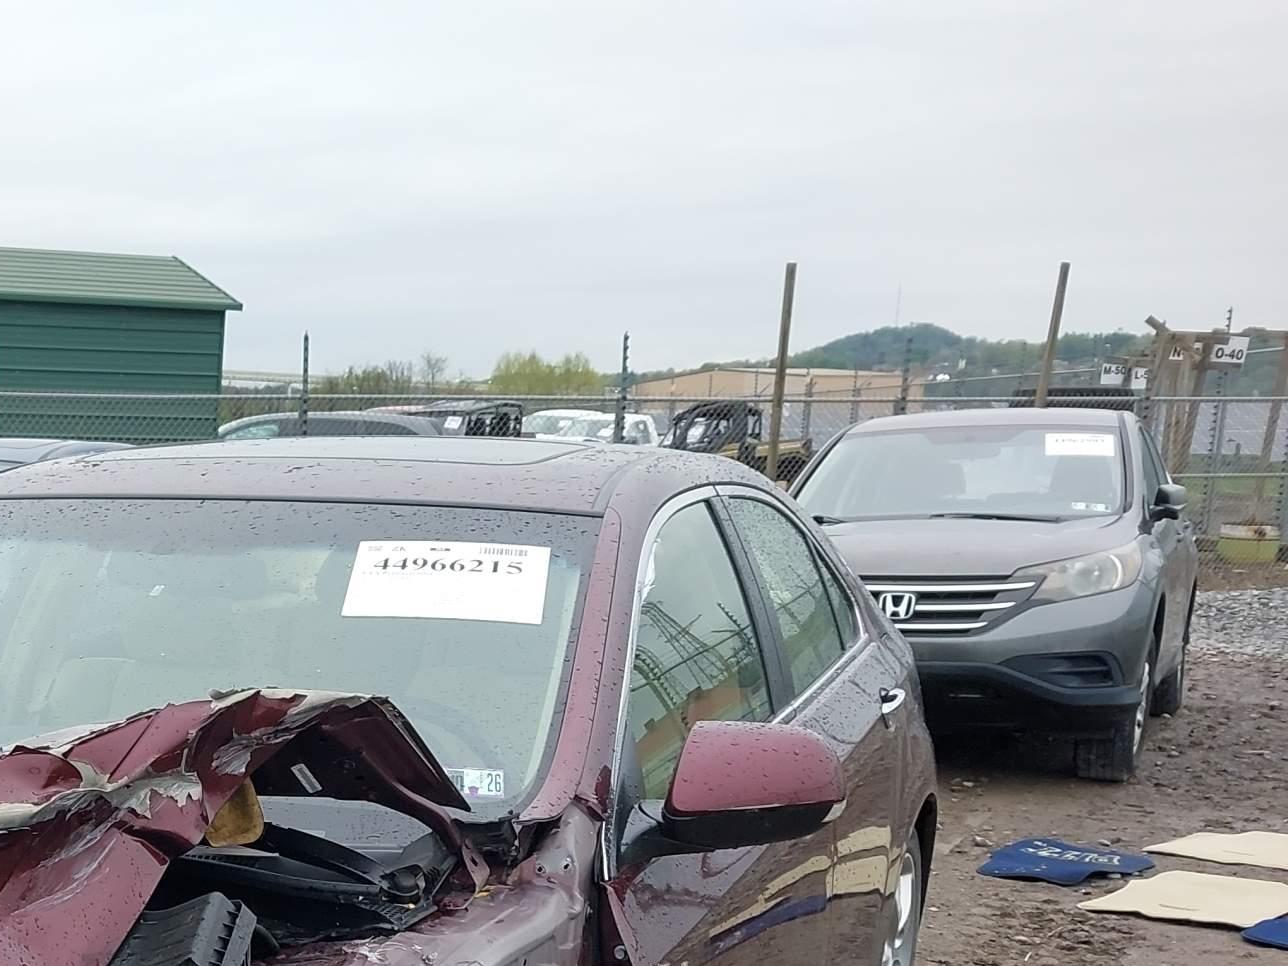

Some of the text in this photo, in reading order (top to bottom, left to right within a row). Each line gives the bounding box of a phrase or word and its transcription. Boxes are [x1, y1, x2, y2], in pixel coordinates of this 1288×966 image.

[1103, 365, 1127, 375] M-50
[373, 557, 524, 575] 44966215
[487, 773, 502, 793] 26
